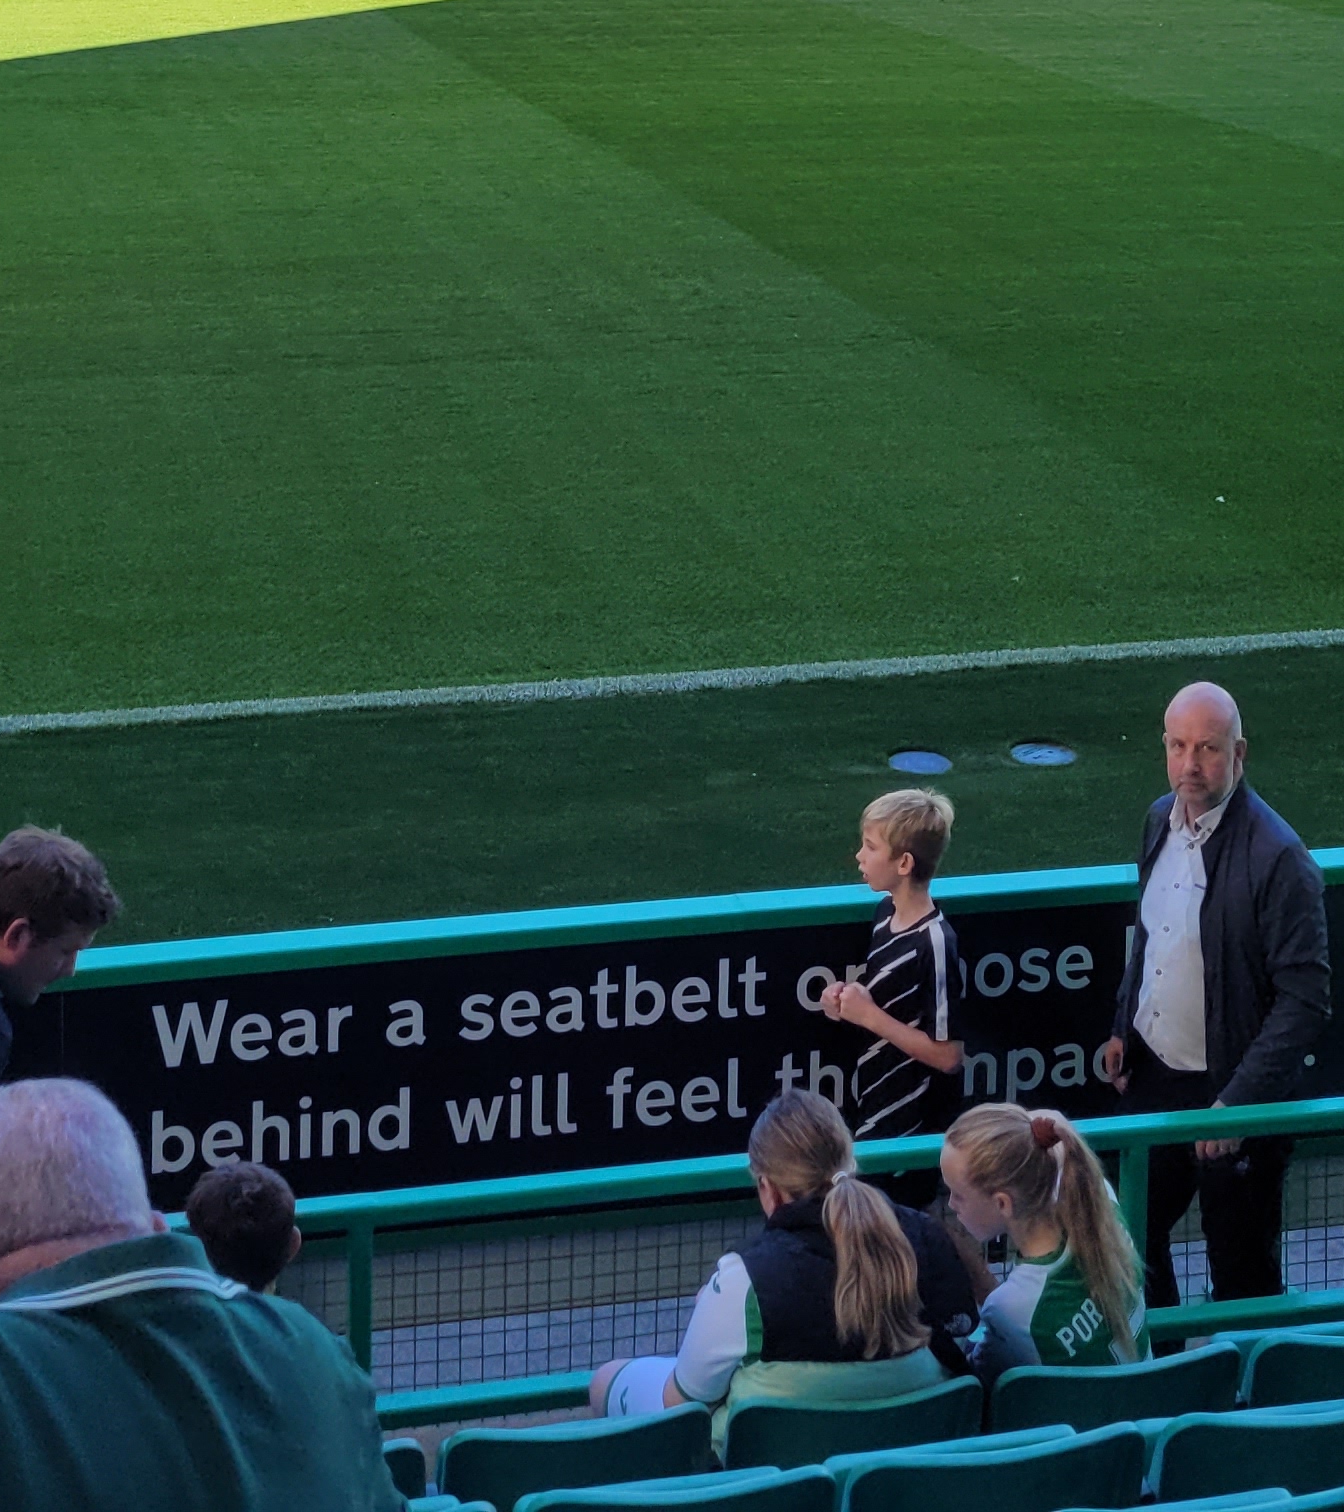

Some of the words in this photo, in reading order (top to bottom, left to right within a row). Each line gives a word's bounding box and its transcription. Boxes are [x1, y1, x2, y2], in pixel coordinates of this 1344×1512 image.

[152, 999, 353, 1068] Wear
[386, 1000, 426, 1047] a
[458, 956, 767, 1042] seatbelt
[959, 945, 1094, 999] ose
[151, 1087, 410, 1175] behind
[446, 1073, 577, 1144] will
[606, 1058, 747, 1129] feel
[775, 1050, 860, 1108] th
